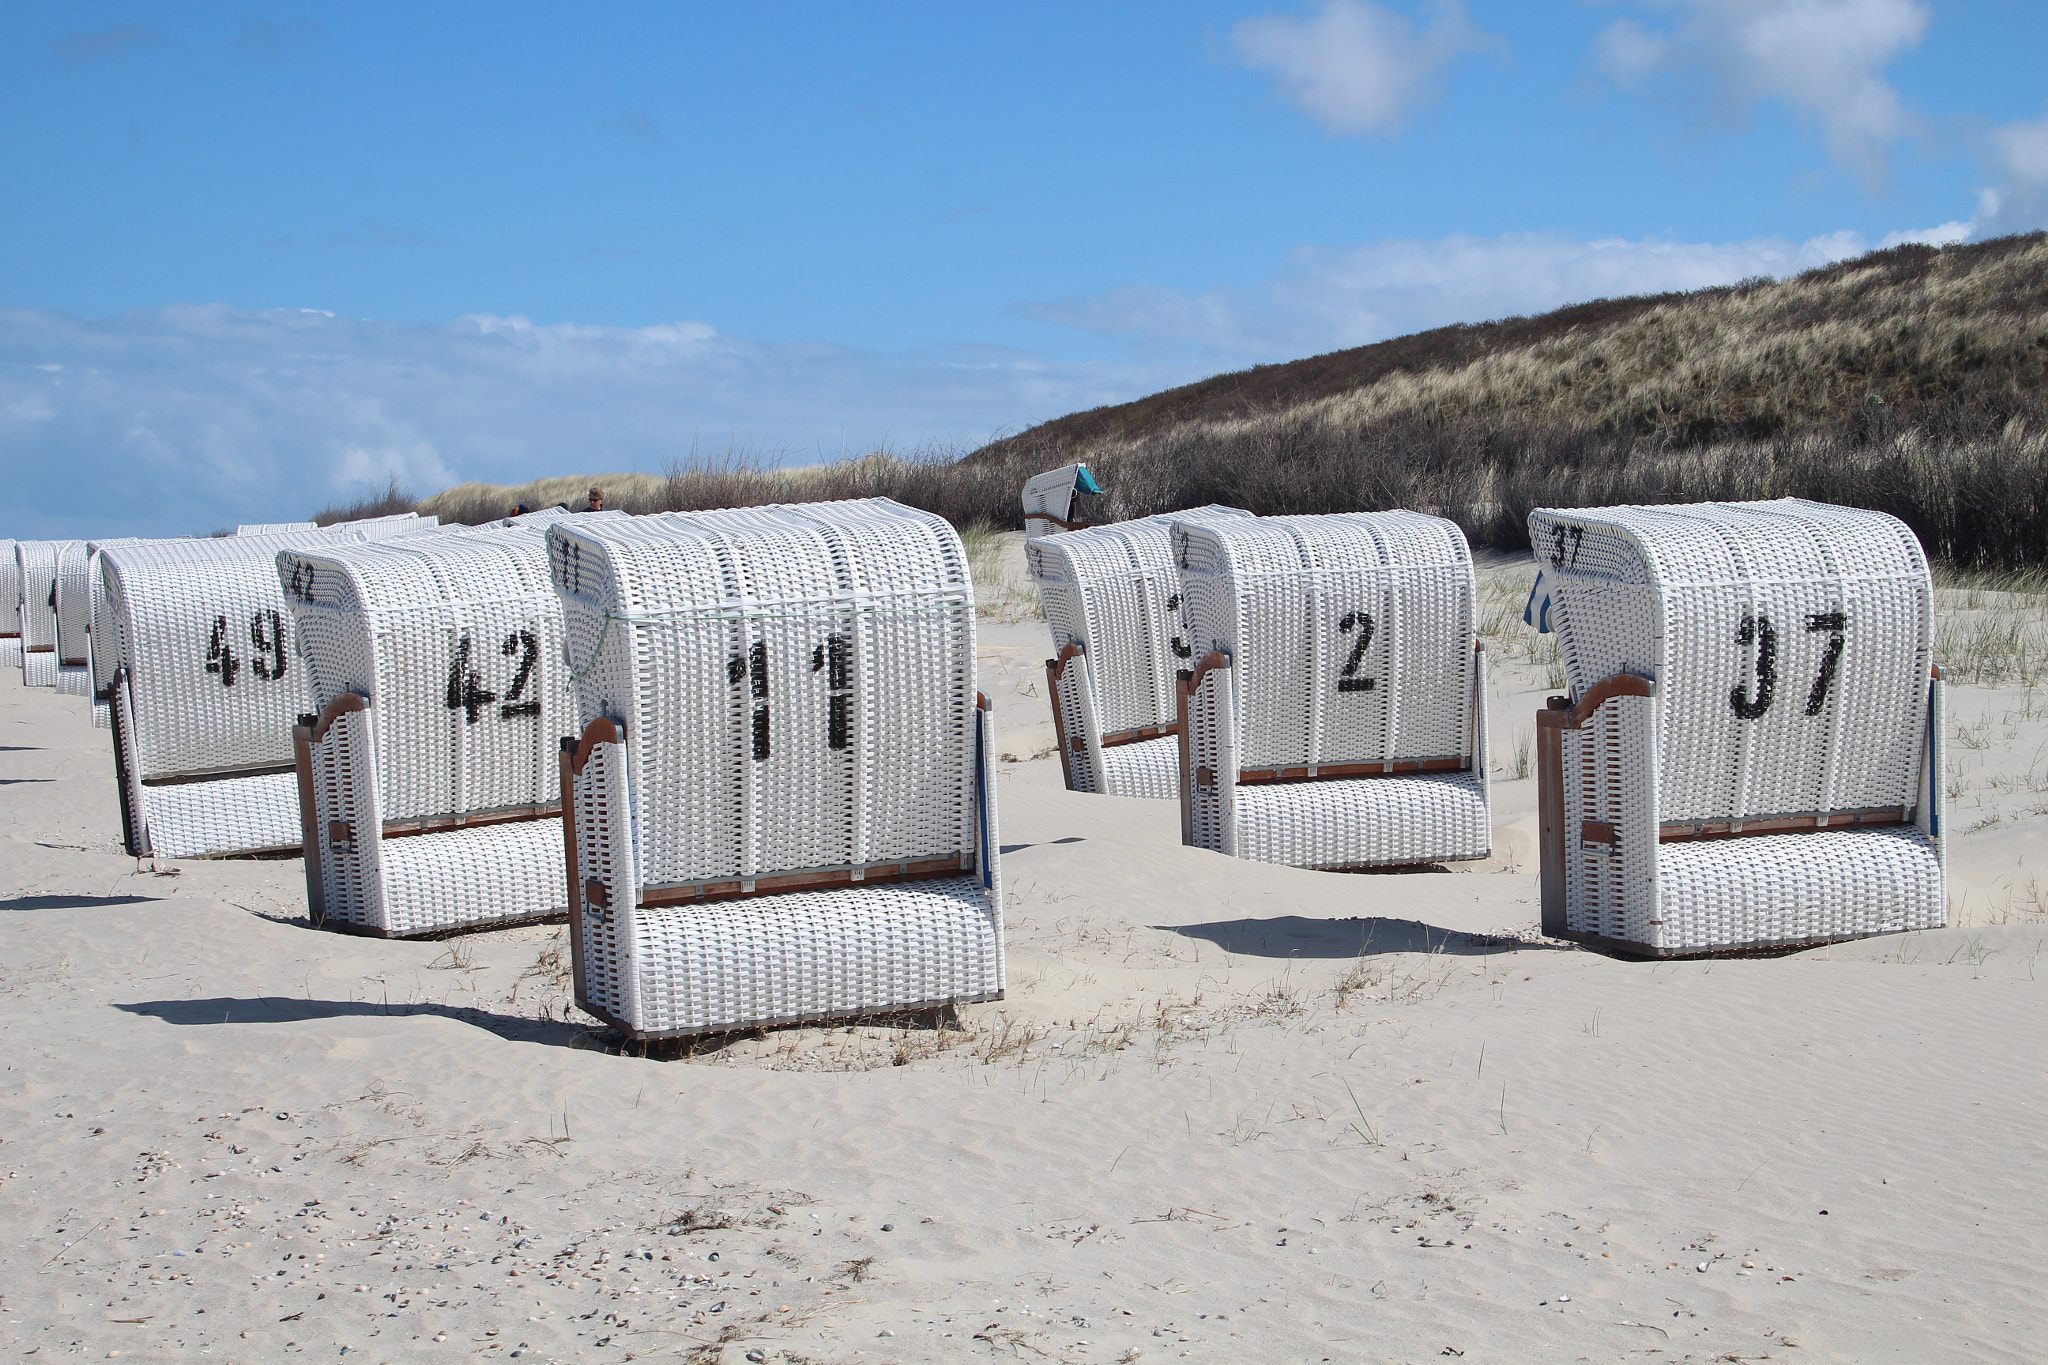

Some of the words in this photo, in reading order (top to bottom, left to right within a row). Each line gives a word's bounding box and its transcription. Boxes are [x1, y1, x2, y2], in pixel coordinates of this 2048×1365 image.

[289, 558, 316, 602] 42
[1551, 525, 1583, 568] 37
[206, 609, 286, 687] 49
[446, 629, 541, 724] 42
[1337, 611, 1374, 693] 2
[1729, 612, 1848, 720] 37
[728, 632, 847, 760] 11
